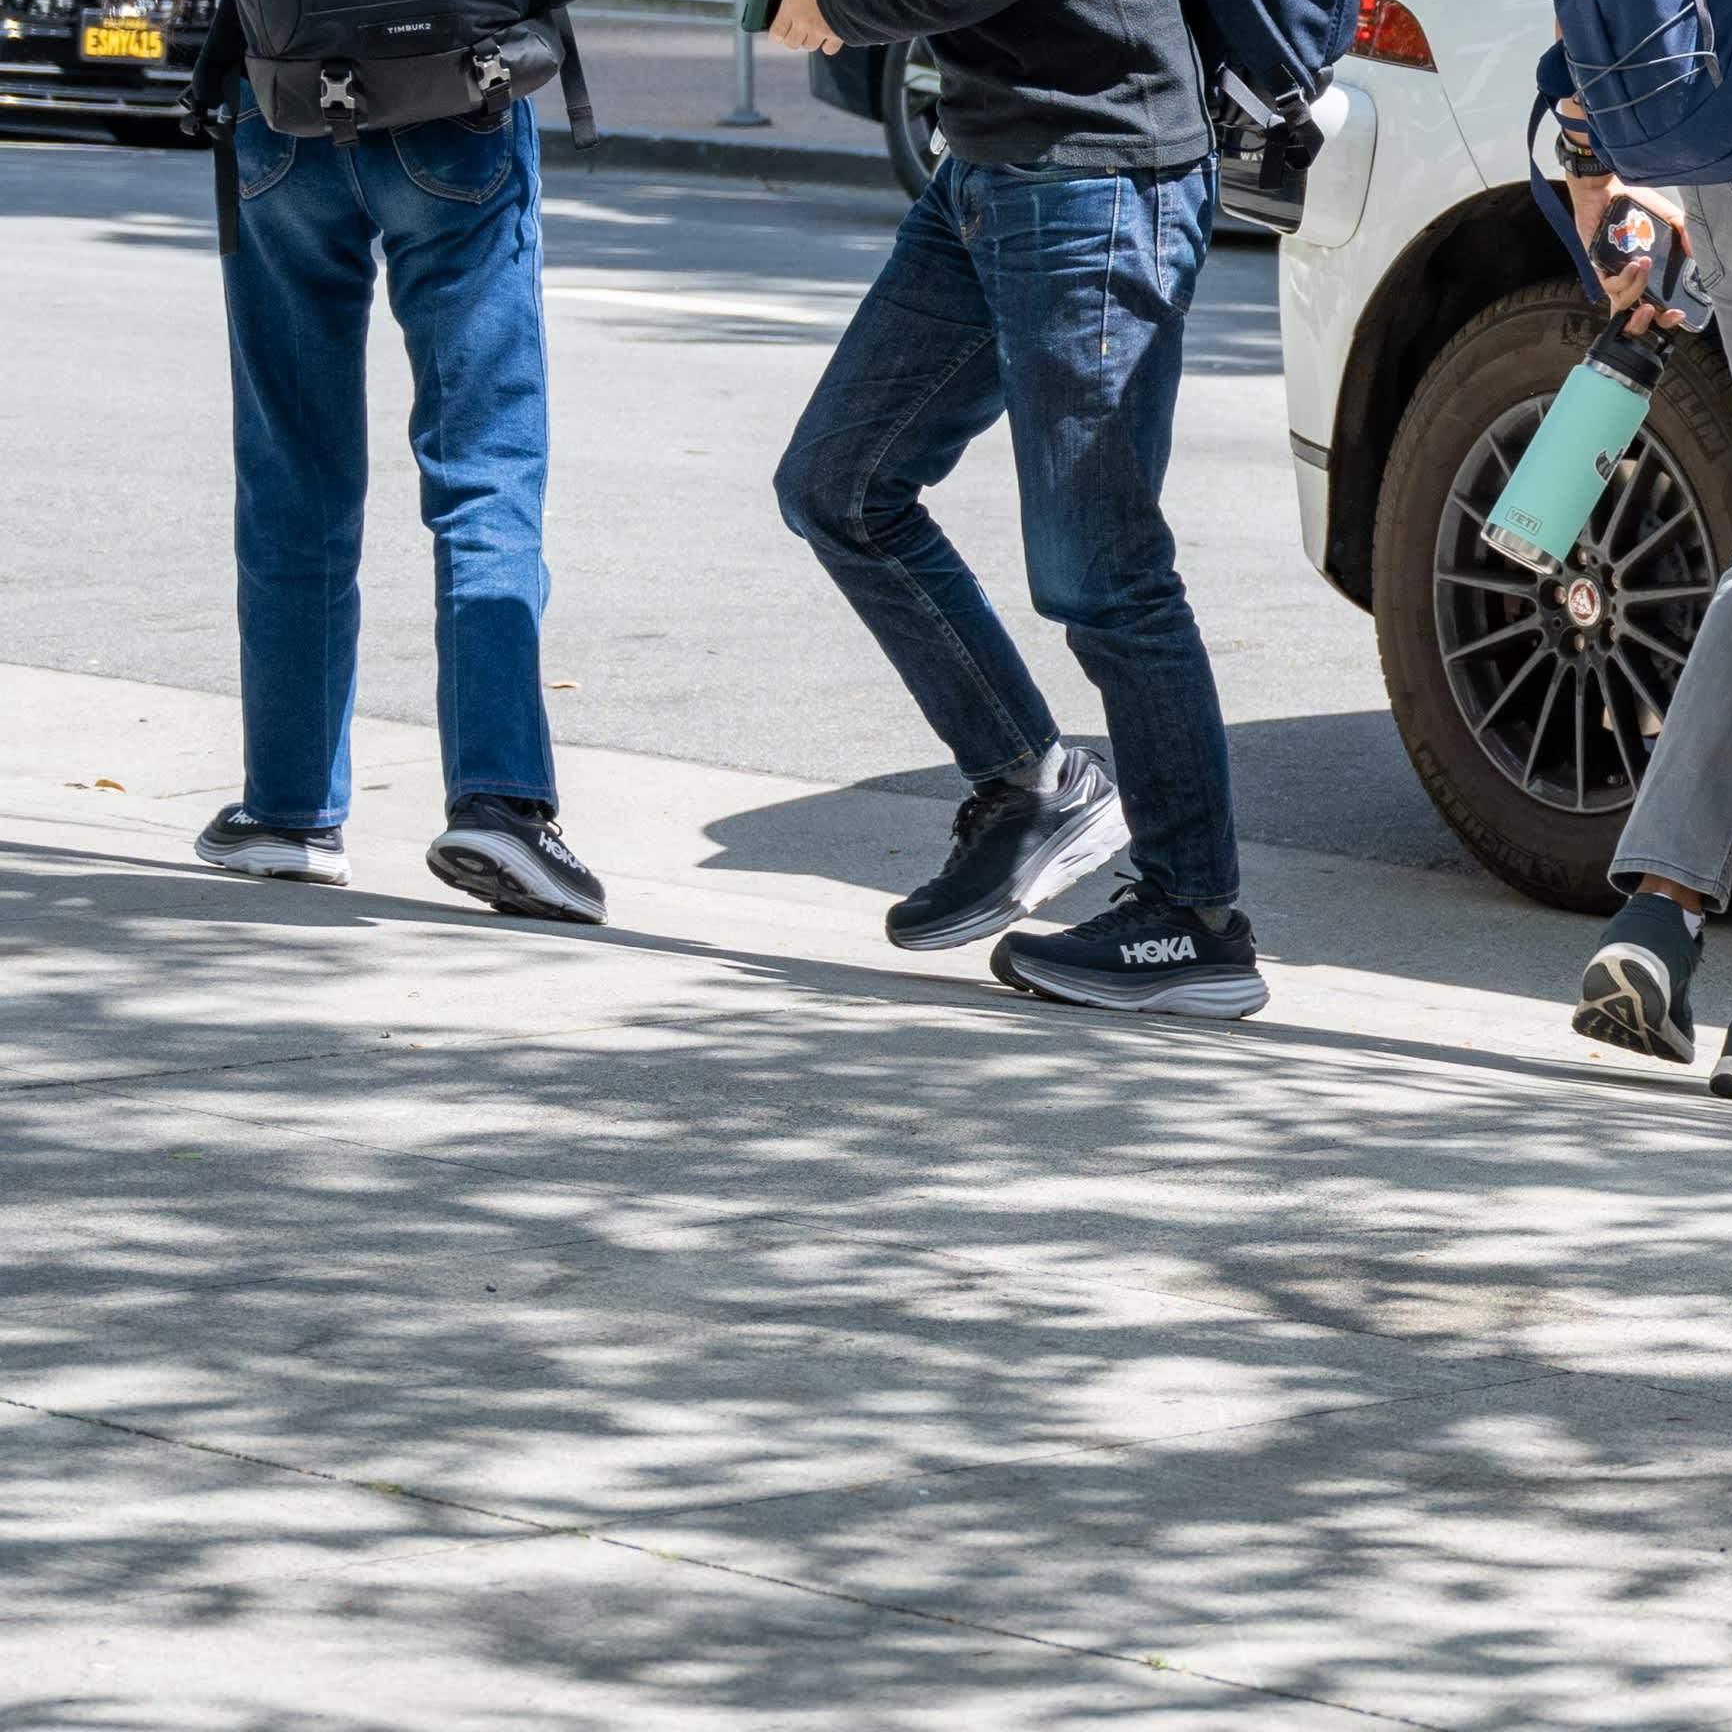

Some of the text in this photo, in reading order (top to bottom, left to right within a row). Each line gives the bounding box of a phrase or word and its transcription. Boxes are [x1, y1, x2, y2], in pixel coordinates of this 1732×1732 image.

[387, 23, 432, 34] TIMBUK2
[1510, 509, 1539, 532] YETI
[1119, 935, 1198, 965] HOKA
